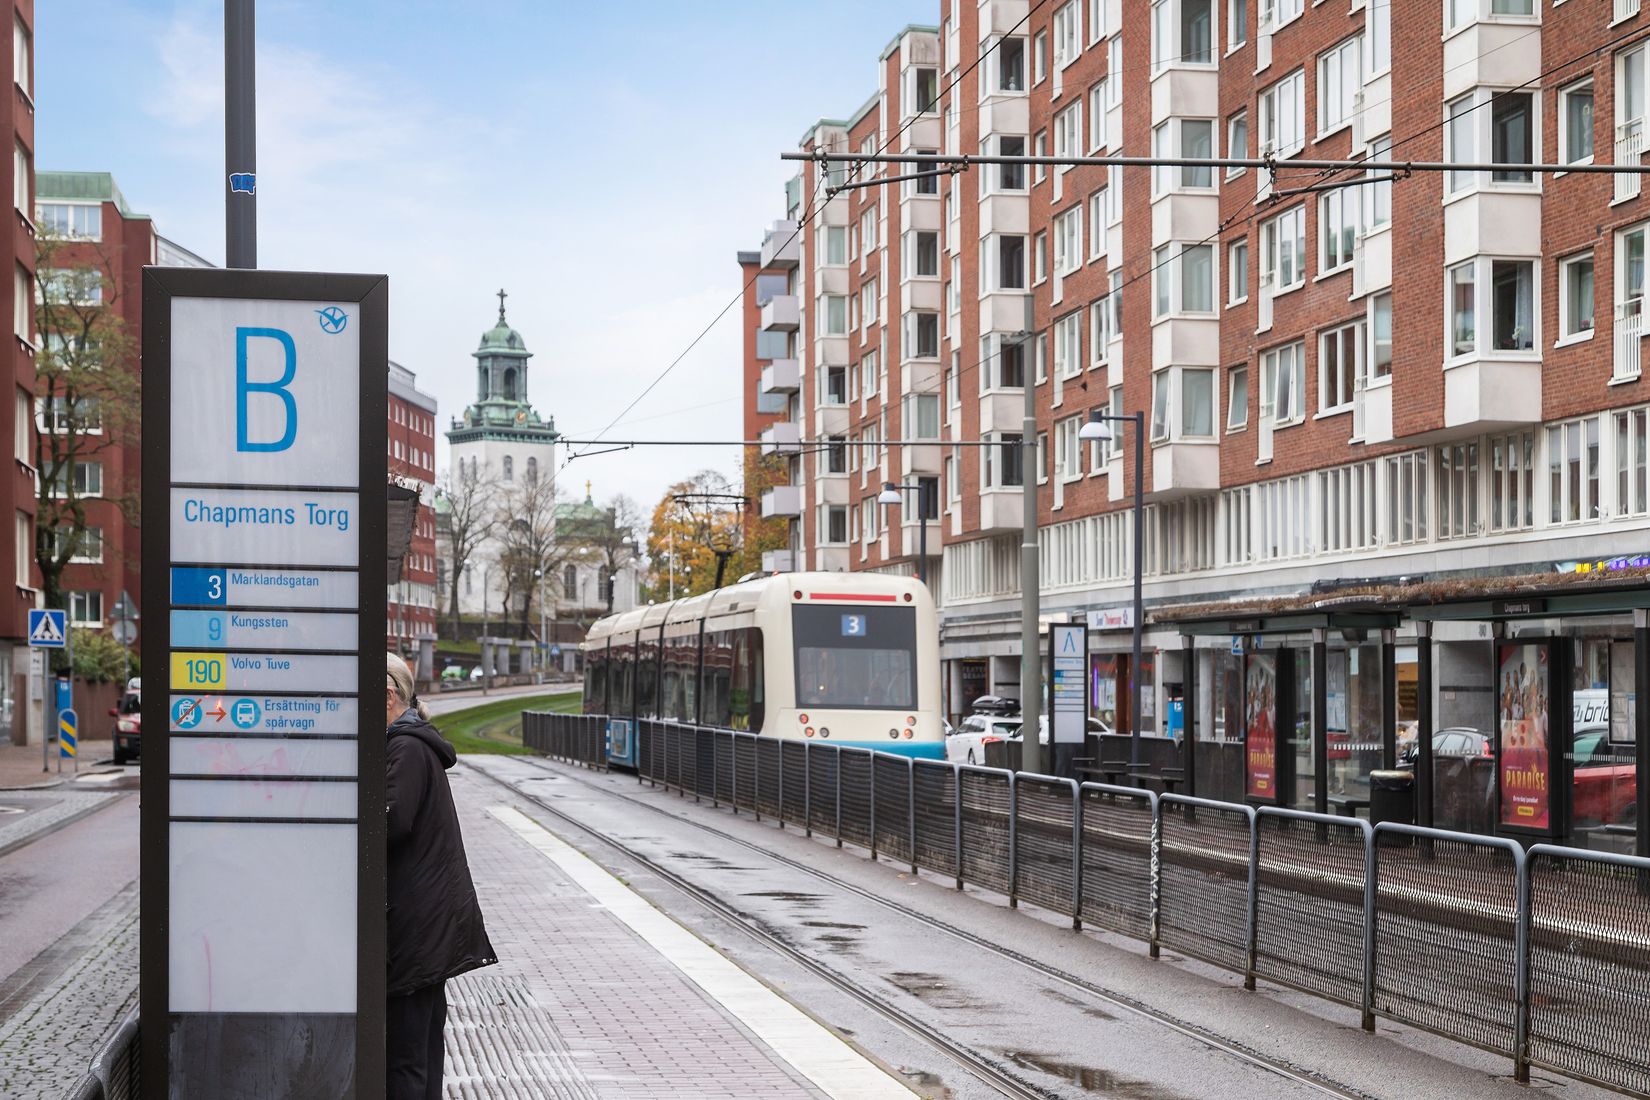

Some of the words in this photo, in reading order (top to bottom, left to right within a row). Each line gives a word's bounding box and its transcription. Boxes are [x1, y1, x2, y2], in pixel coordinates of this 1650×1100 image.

[235, 326, 298, 453] B
[184, 499, 296, 529] Chapmans
[304, 502, 349, 532] Torg
[207, 574, 222, 600] 3
[231, 573, 319, 589] Marklandsgatan
[207, 617, 222, 641] 9
[231, 615, 289, 631] Kungssten
[847, 615, 860, 634] 3
[185, 659, 222, 684] 190
[231, 657, 261, 670] Volvo
[266, 657, 291, 670] Tuve
[264, 698, 321, 714] Ersättning
[325, 699, 341, 713] för
[264, 714, 315, 731] spårvagn
[1505, 768, 1546, 791] PARADISE
